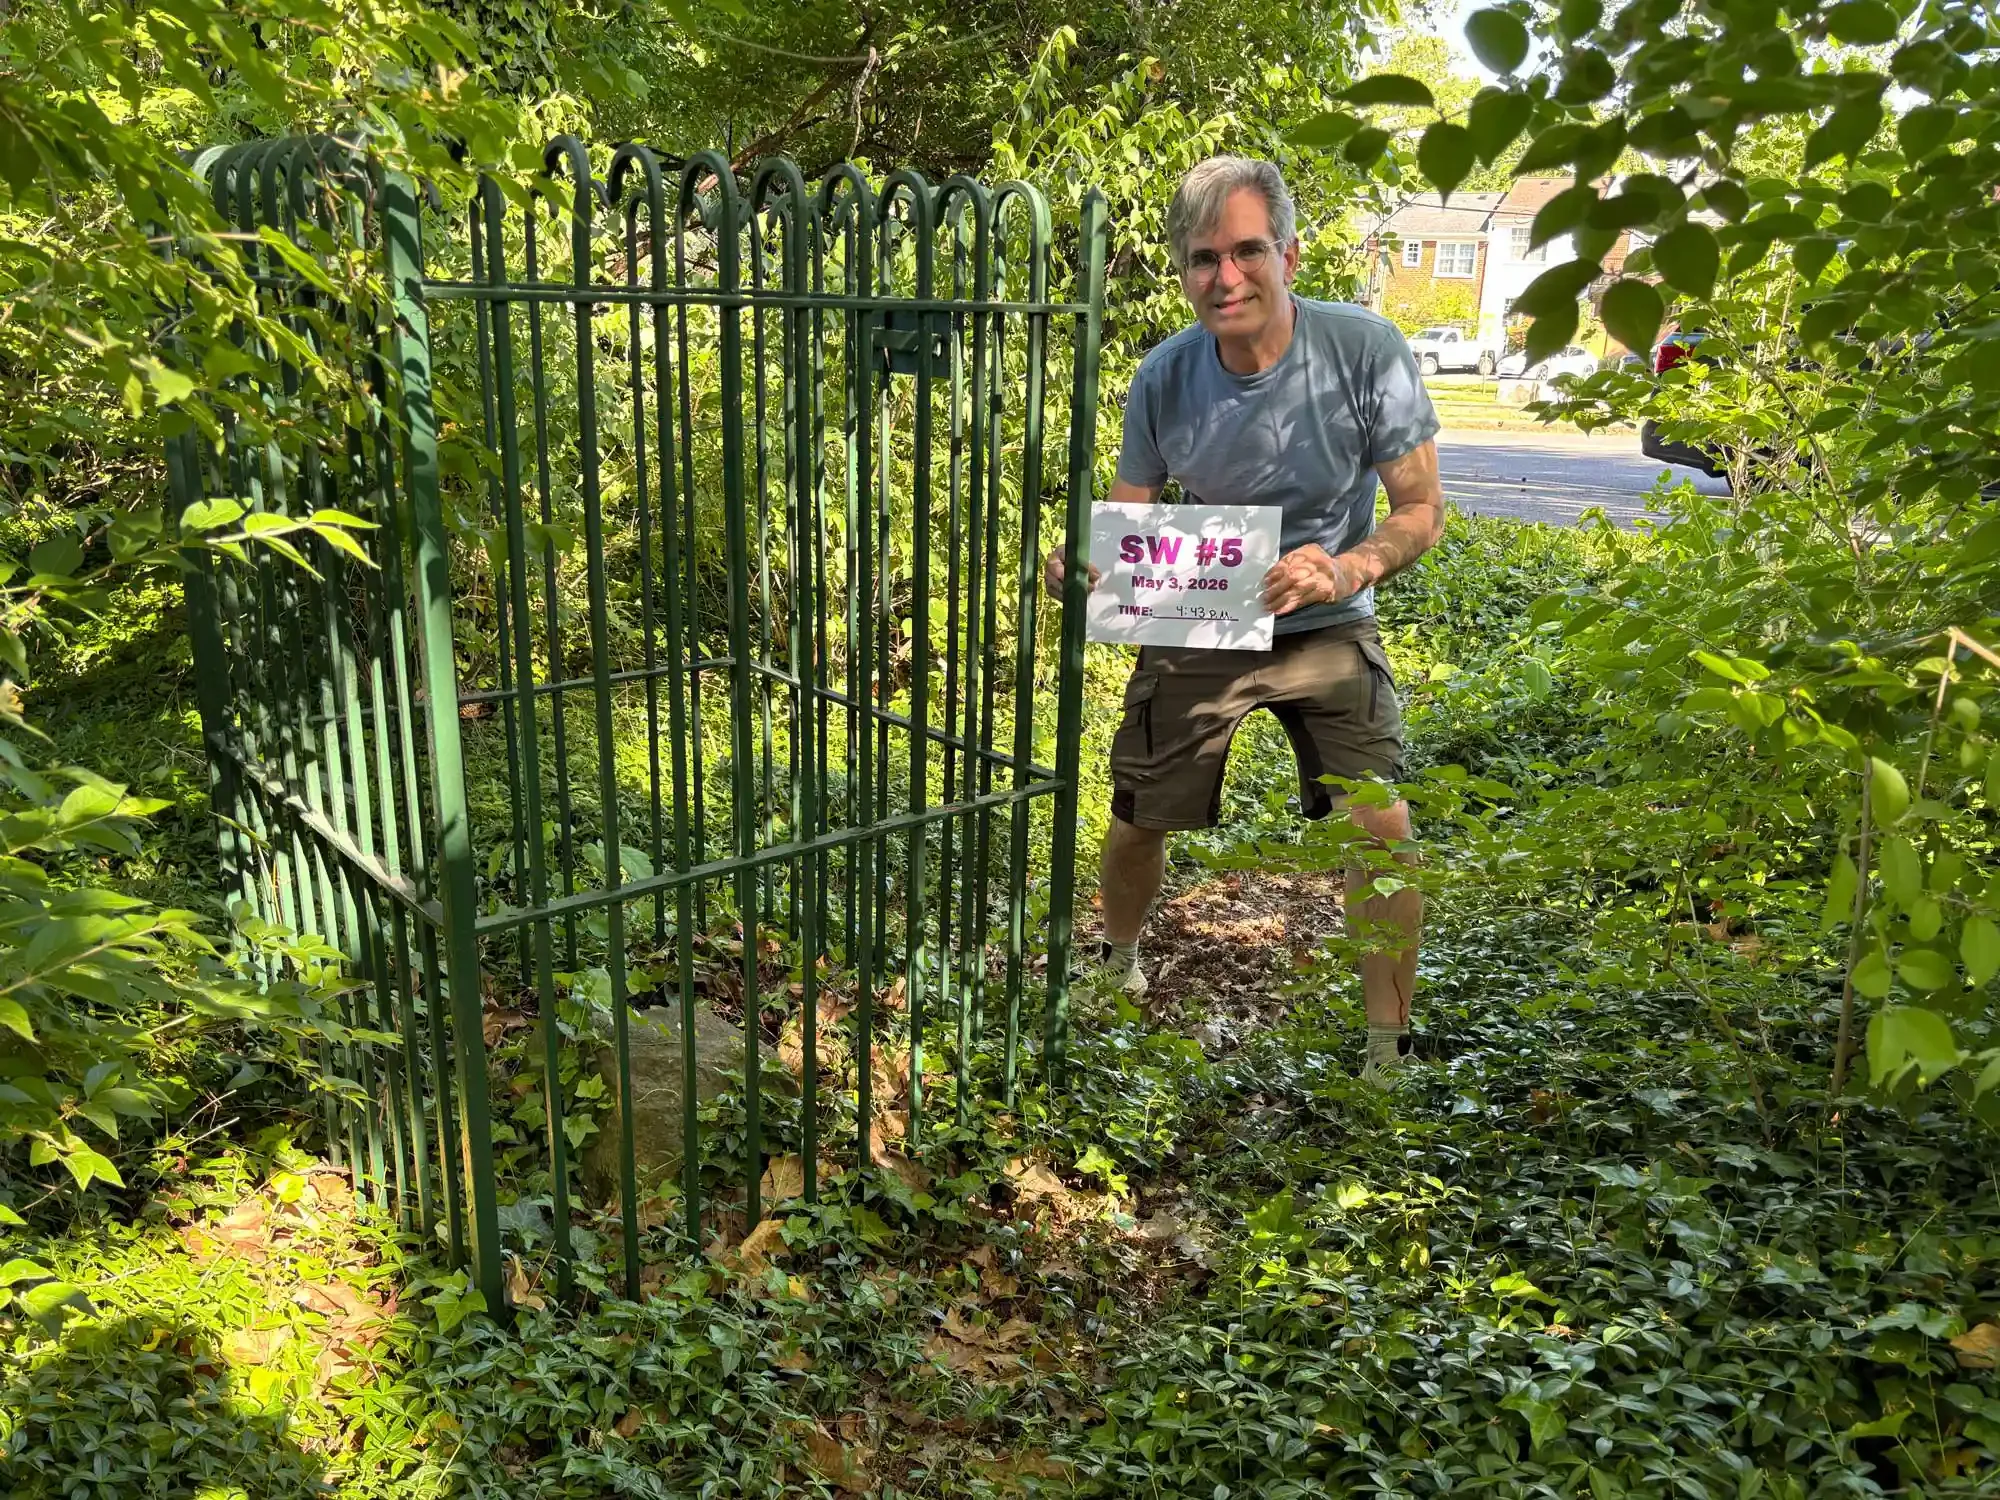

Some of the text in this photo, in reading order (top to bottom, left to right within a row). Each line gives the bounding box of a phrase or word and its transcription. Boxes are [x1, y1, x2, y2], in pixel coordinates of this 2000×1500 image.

[1119, 534, 1243, 567] SW #5
[1131, 576, 1228, 592] May 3, 2026
[1118, 605, 1153, 616] TIME:
